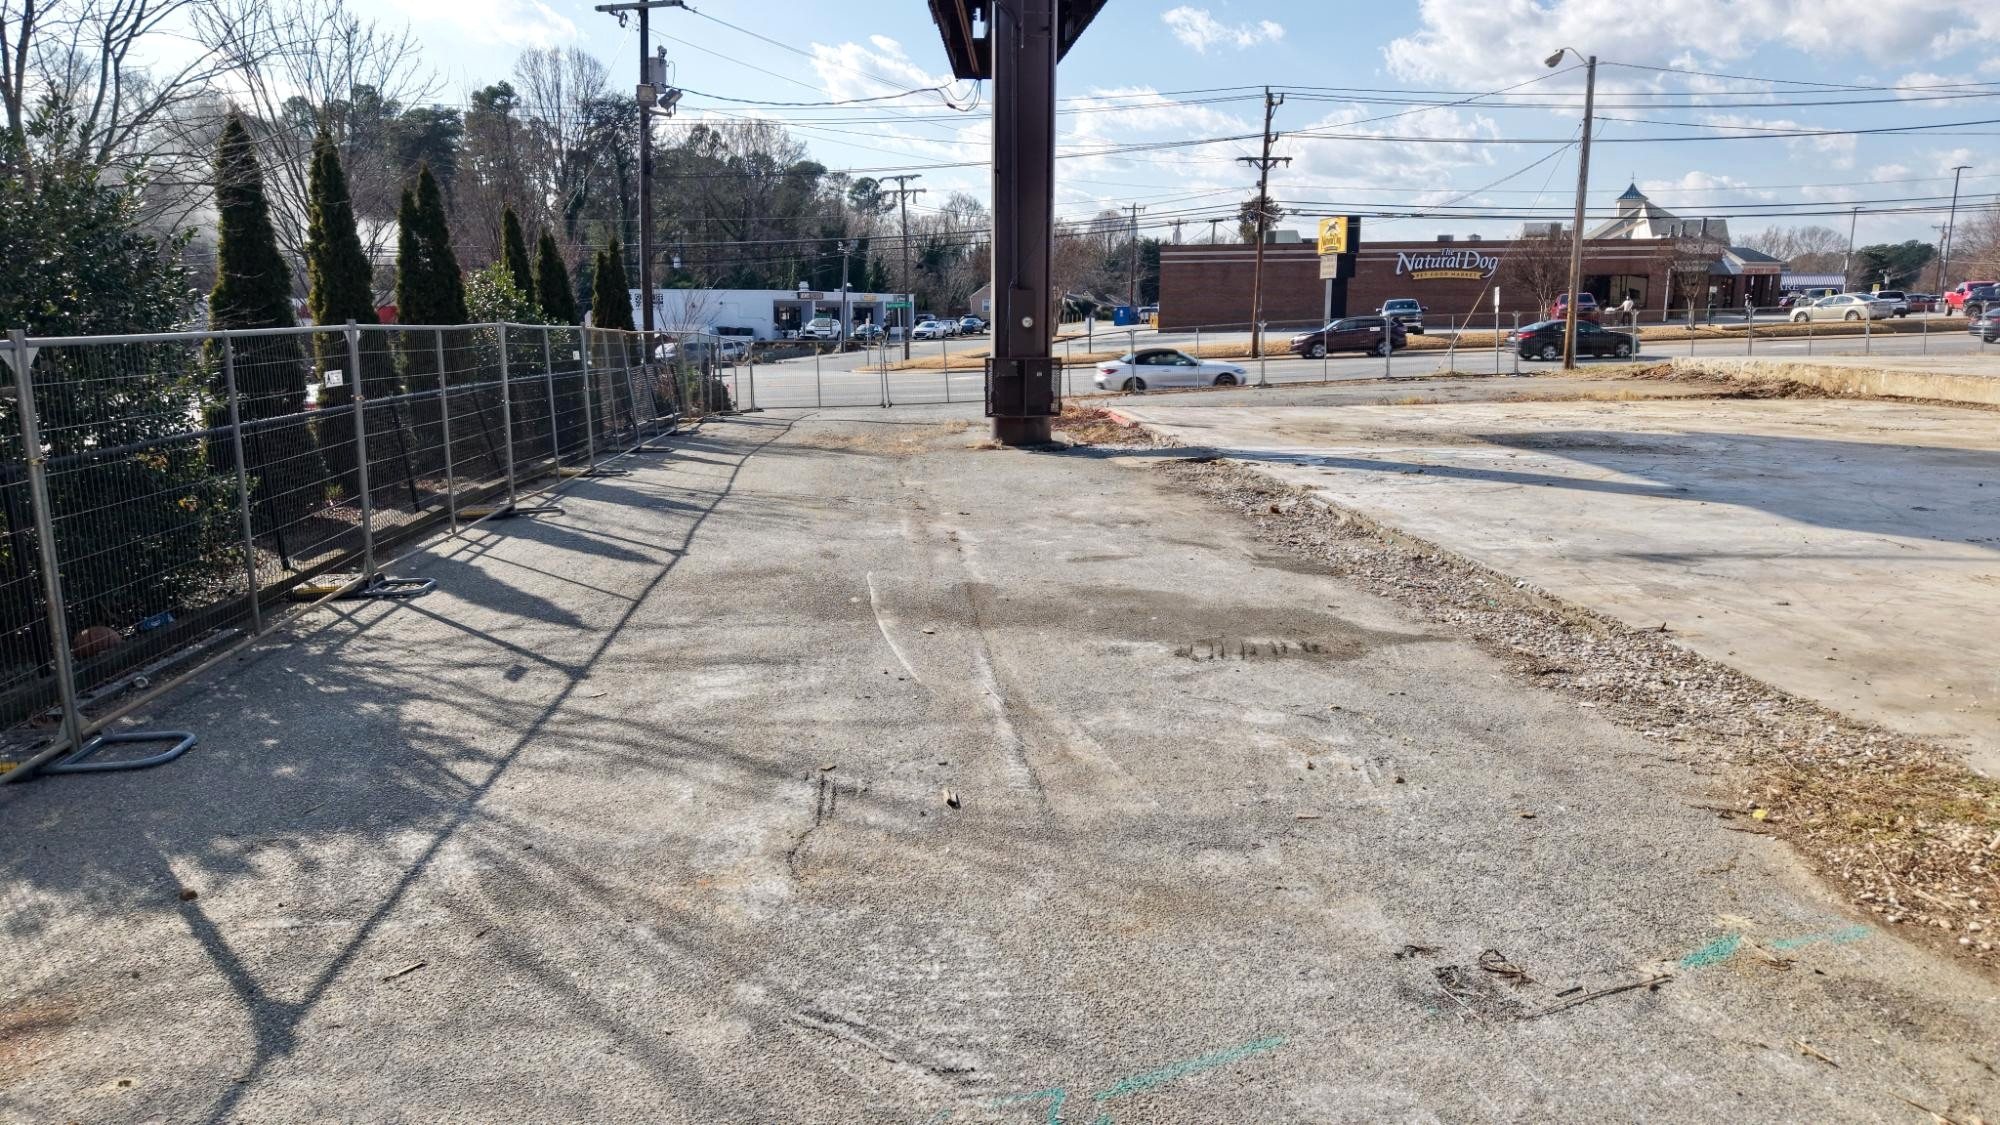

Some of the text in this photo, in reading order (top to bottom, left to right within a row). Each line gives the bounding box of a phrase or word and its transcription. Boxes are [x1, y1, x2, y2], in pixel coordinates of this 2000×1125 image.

[1440, 248, 1455, 256] The
[1395, 250, 1499, 278] Natural Dog
